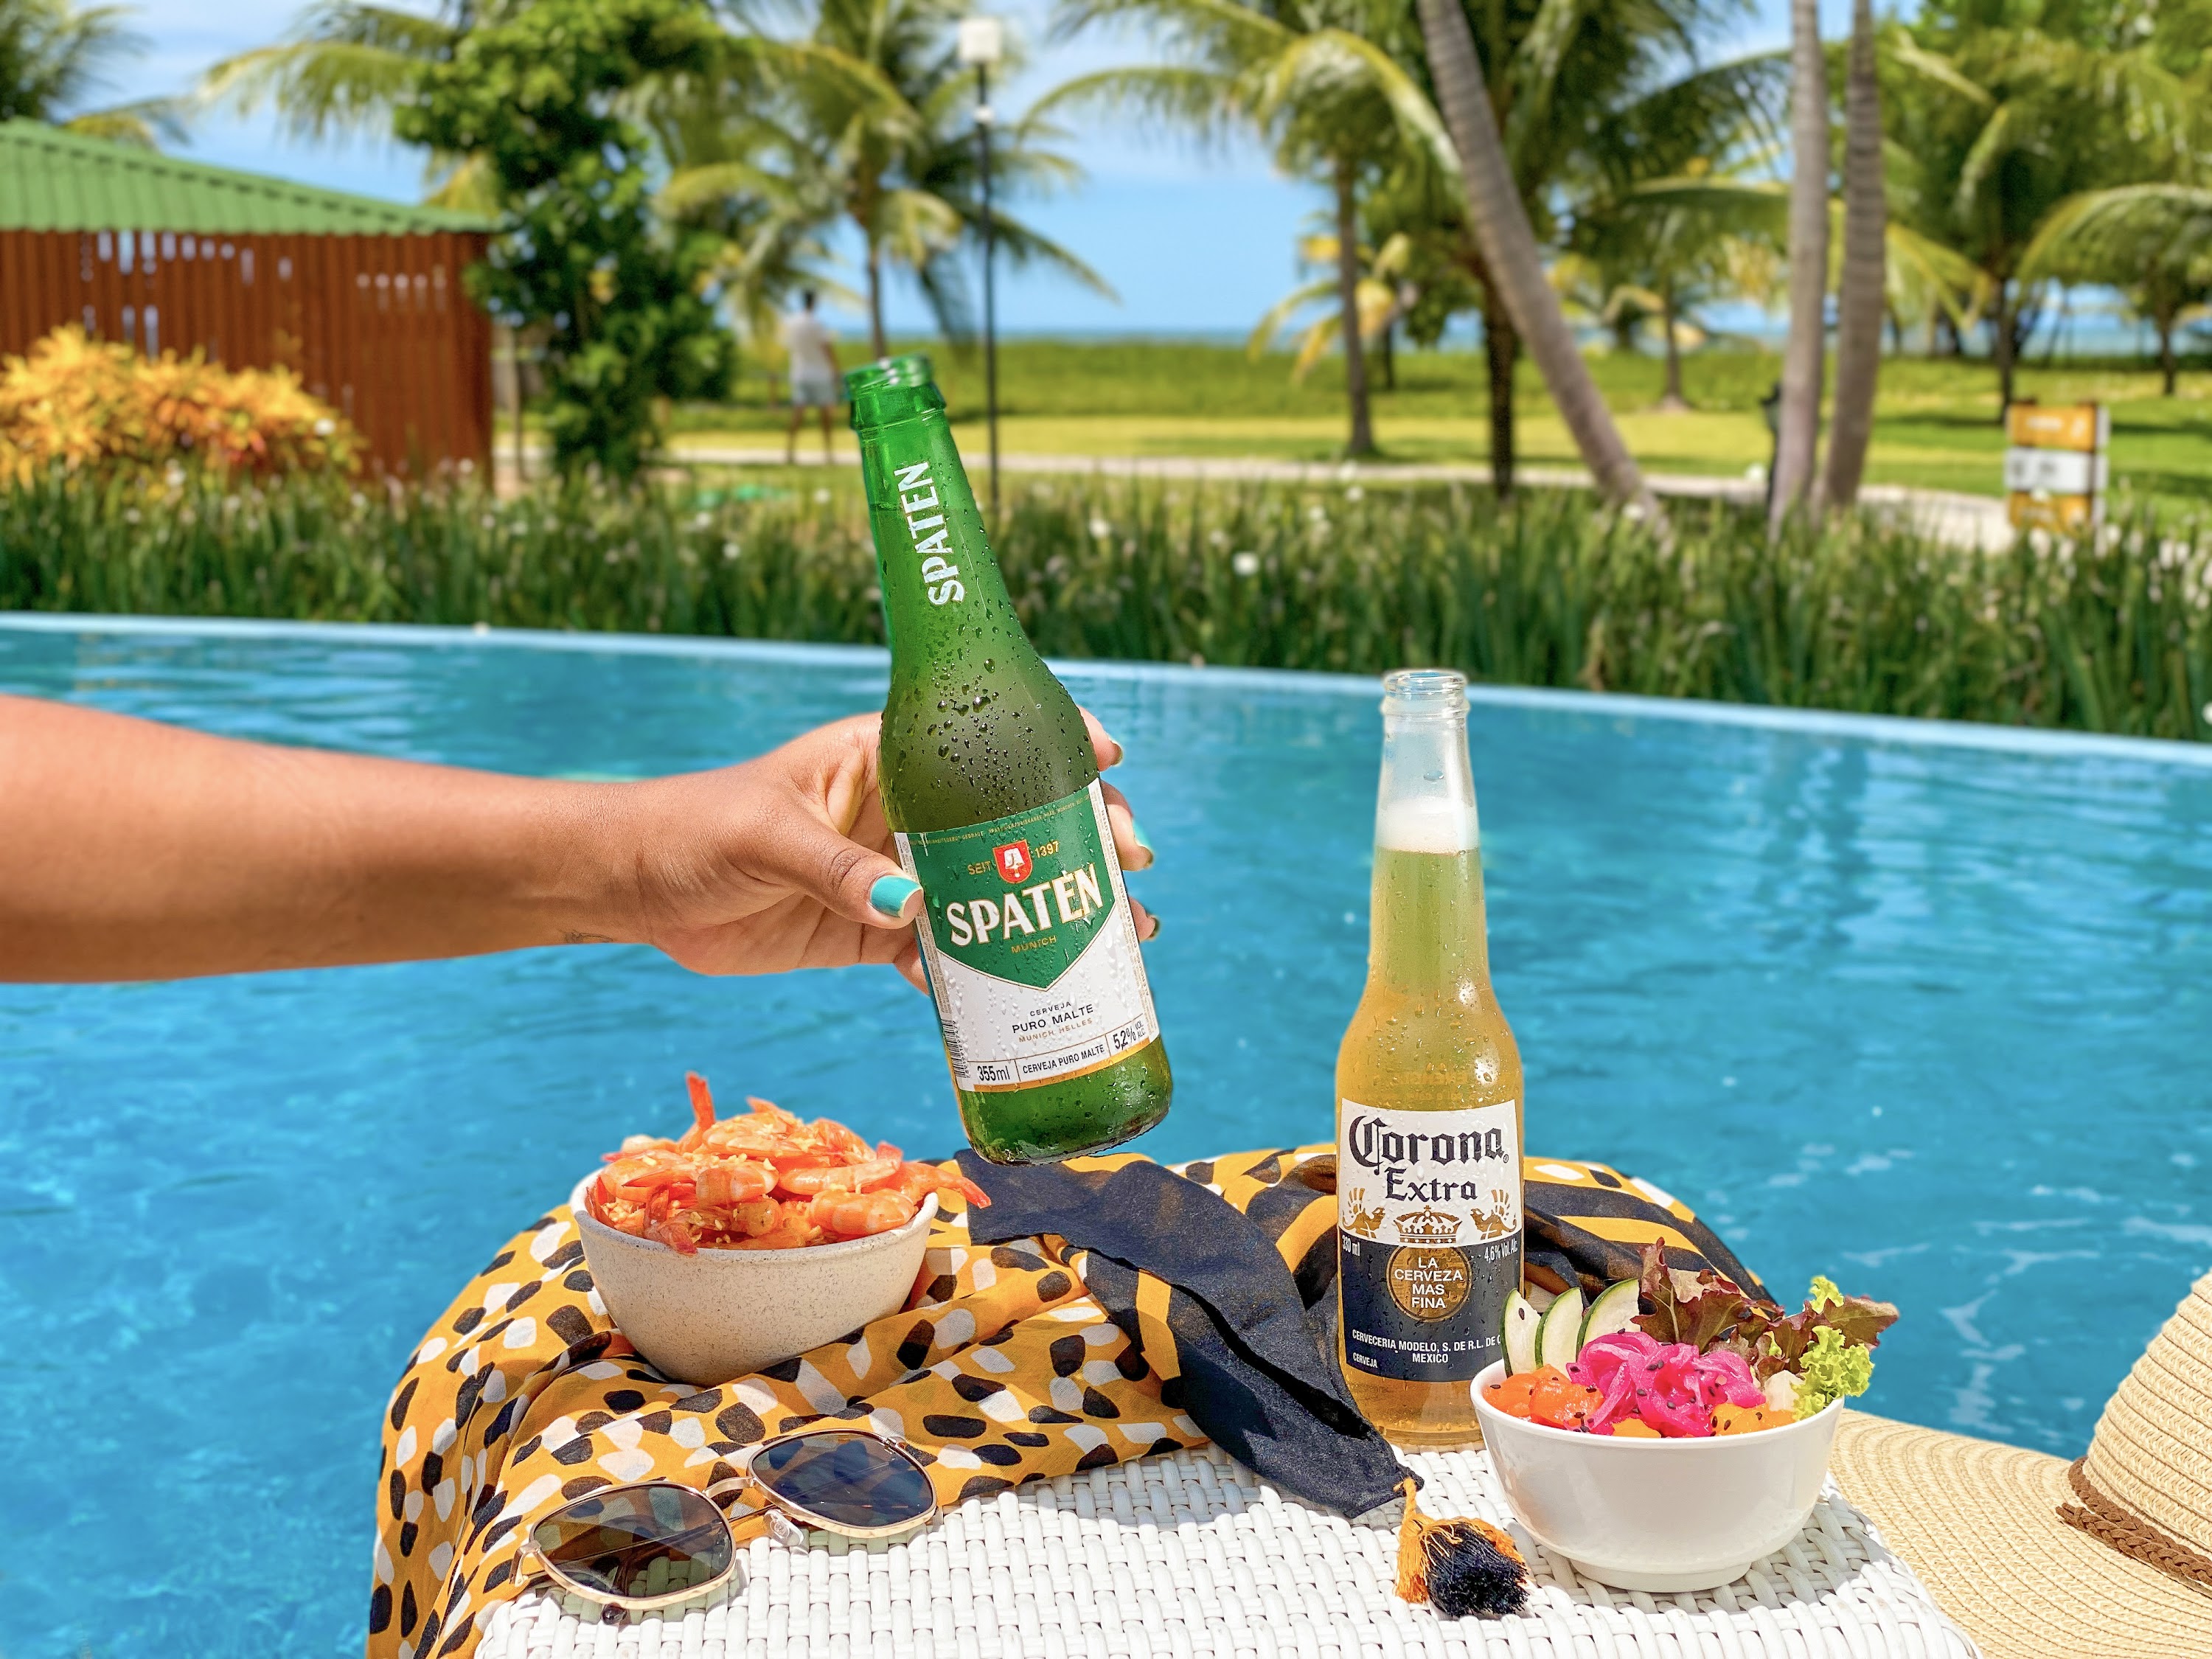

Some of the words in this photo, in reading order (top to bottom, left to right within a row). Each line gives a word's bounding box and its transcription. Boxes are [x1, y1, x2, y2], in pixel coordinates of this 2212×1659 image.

[894, 462, 966, 605] SPATEN
[967, 860, 992, 875] SEIT
[1034, 841, 1060, 858] 1397
[946, 862, 1104, 947] SPATEN
[1011, 935, 1057, 953] MUNICH
[1012, 1019, 1046, 1033] PURO
[1051, 1004, 1093, 1025] MALTE
[1029, 1001, 1071, 1017] CERVEJA
[1019, 1030, 1054, 1043] MUNICH
[1059, 1018, 1093, 1034] HELLES
[1113, 1026, 1136, 1051] 5,2%
[1023, 1060, 1057, 1074] CERVEJA
[1058, 1054, 1079, 1066] PURO
[1081, 1044, 1105, 1060] MALTE
[977, 1065, 1010, 1082] 355ml
[1349, 1115, 1505, 1175] Corona
[1384, 1166, 1478, 1203] Extra
[1342, 1234, 1351, 1255] 330
[1352, 1242, 1360, 1256] ml
[1484, 1245, 1501, 1264] 4,6%
[1501, 1241, 1510, 1258] Vol.
[1418, 1256, 1439, 1268] LA
[1394, 1269, 1464, 1281] CERVEZA
[1411, 1284, 1445, 1295] MAS
[1411, 1297, 1446, 1309] FINA
[1352, 1329, 1397, 1349] CERVECERIA
[1398, 1340, 1440, 1353] MODELO,
[1442, 1342, 1451, 1352] S.
[1453, 1341, 1466, 1352] DE
[1468, 1339, 1484, 1350] R.L.
[1485, 1335, 1496, 1347] DE
[1352, 1352, 1378, 1368] CERVEJA
[1412, 1353, 1449, 1363] MEXICO
